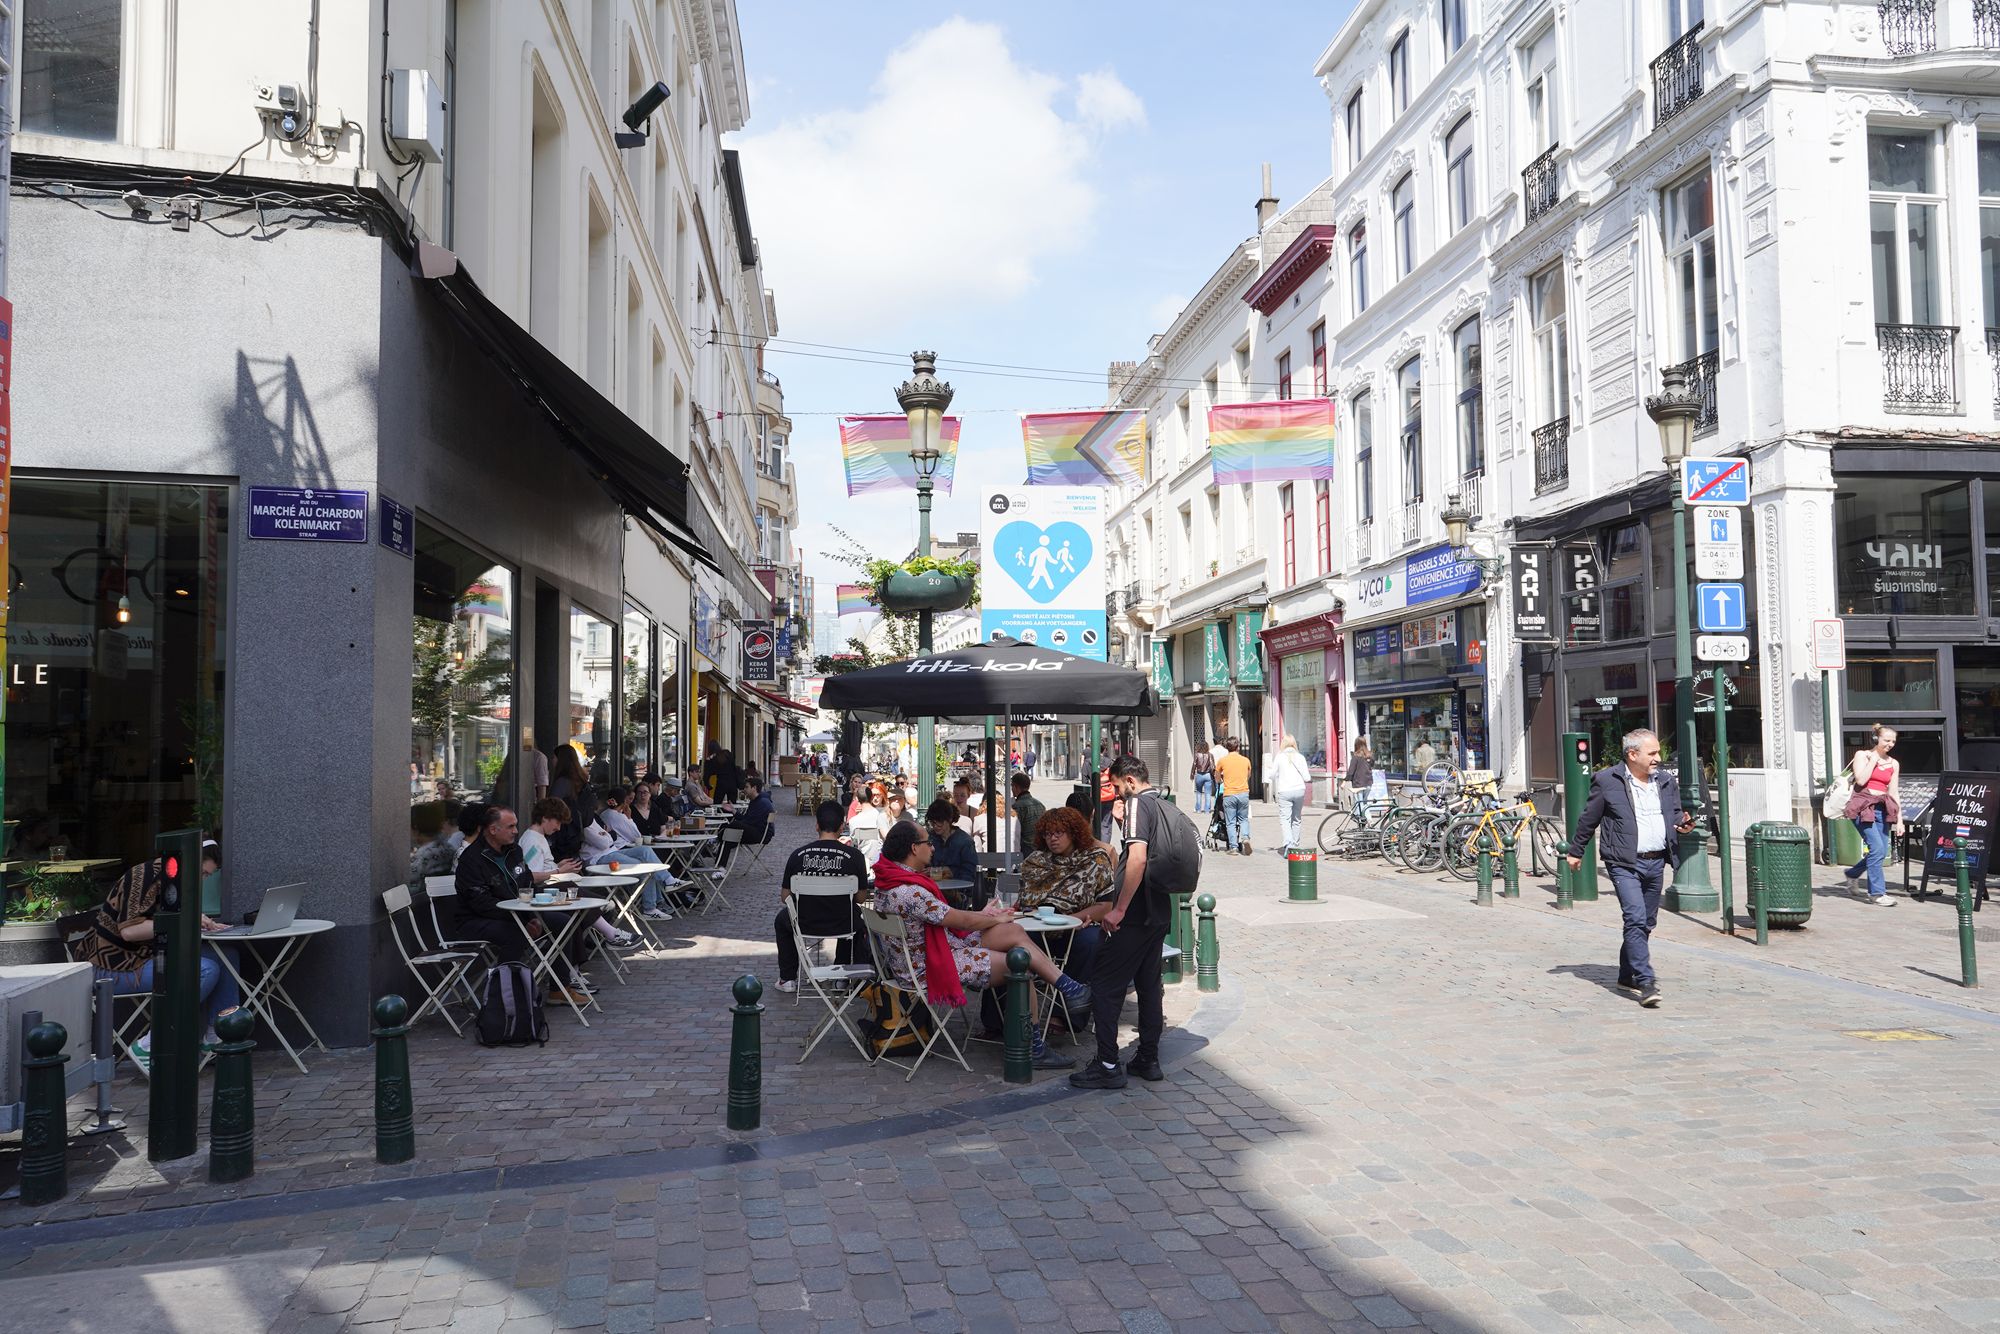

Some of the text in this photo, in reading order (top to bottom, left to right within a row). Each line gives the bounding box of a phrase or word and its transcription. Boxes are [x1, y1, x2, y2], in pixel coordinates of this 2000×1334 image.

[253, 504, 363, 519] MARCHÉ AU CHARBON
[274, 519, 341, 531] KOLENMARKT
[1408, 556, 1438, 575] BRUSSELS
[1410, 567, 1454, 589] CONVENIENCE
[1455, 562, 1476, 577] STORE
[1359, 576, 1384, 603] Lyca
[1874, 578, 1937, 593] ร้านอาหารไทย
[1468, 644, 1480, 658] ria
[1582, 765, 1589, 774] 2
[1949, 783, 1987, 798] LUNCH
[1954, 815, 1974, 825] STREET
